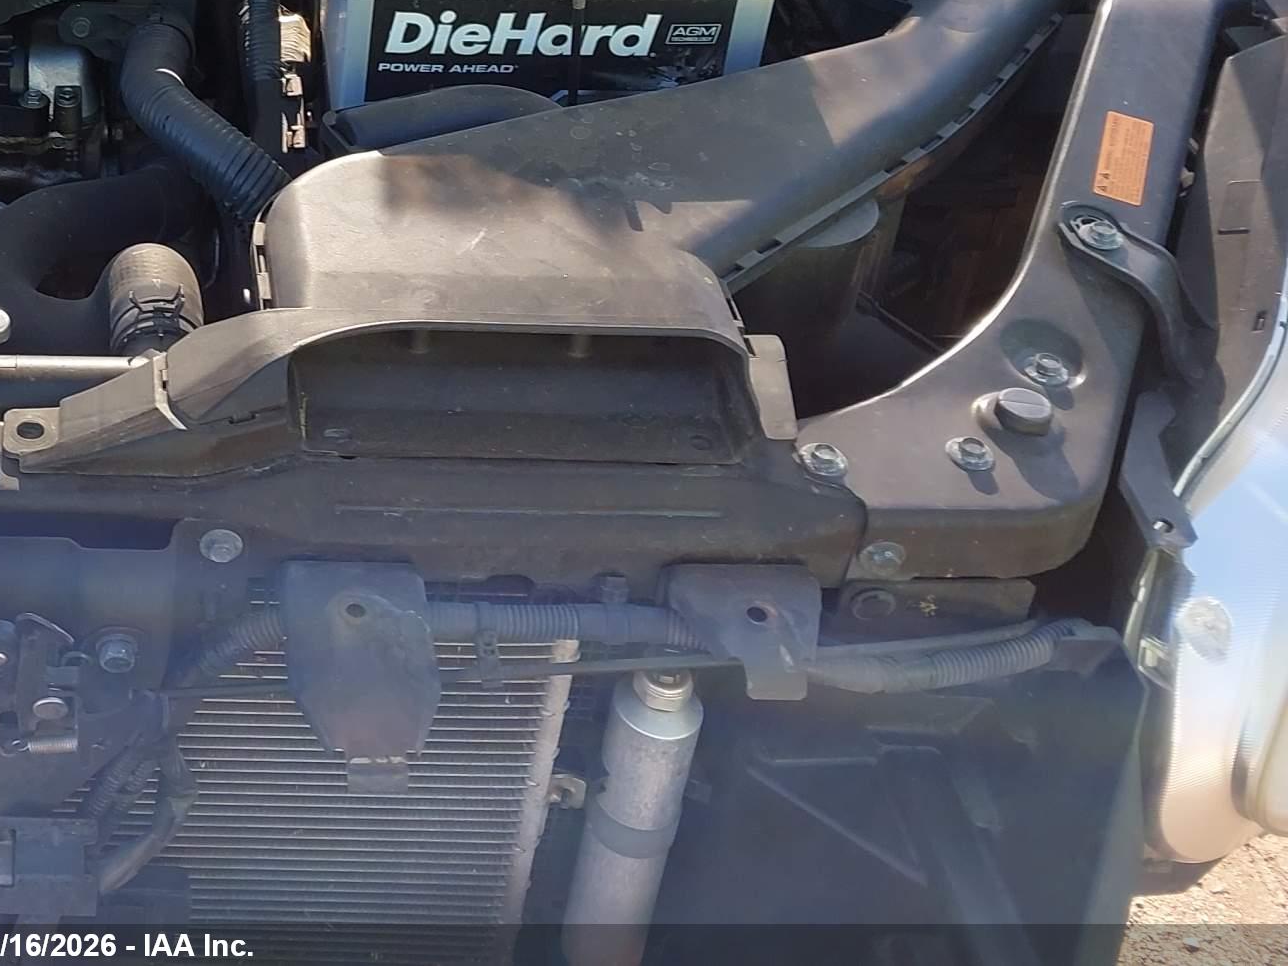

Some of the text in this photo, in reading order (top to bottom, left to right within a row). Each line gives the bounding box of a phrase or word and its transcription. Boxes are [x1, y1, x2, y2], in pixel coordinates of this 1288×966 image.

[384, 10, 662, 56] DieHard
[672, 26, 717, 36] AGM
[378, 63, 514, 74] POWER AHEAD
